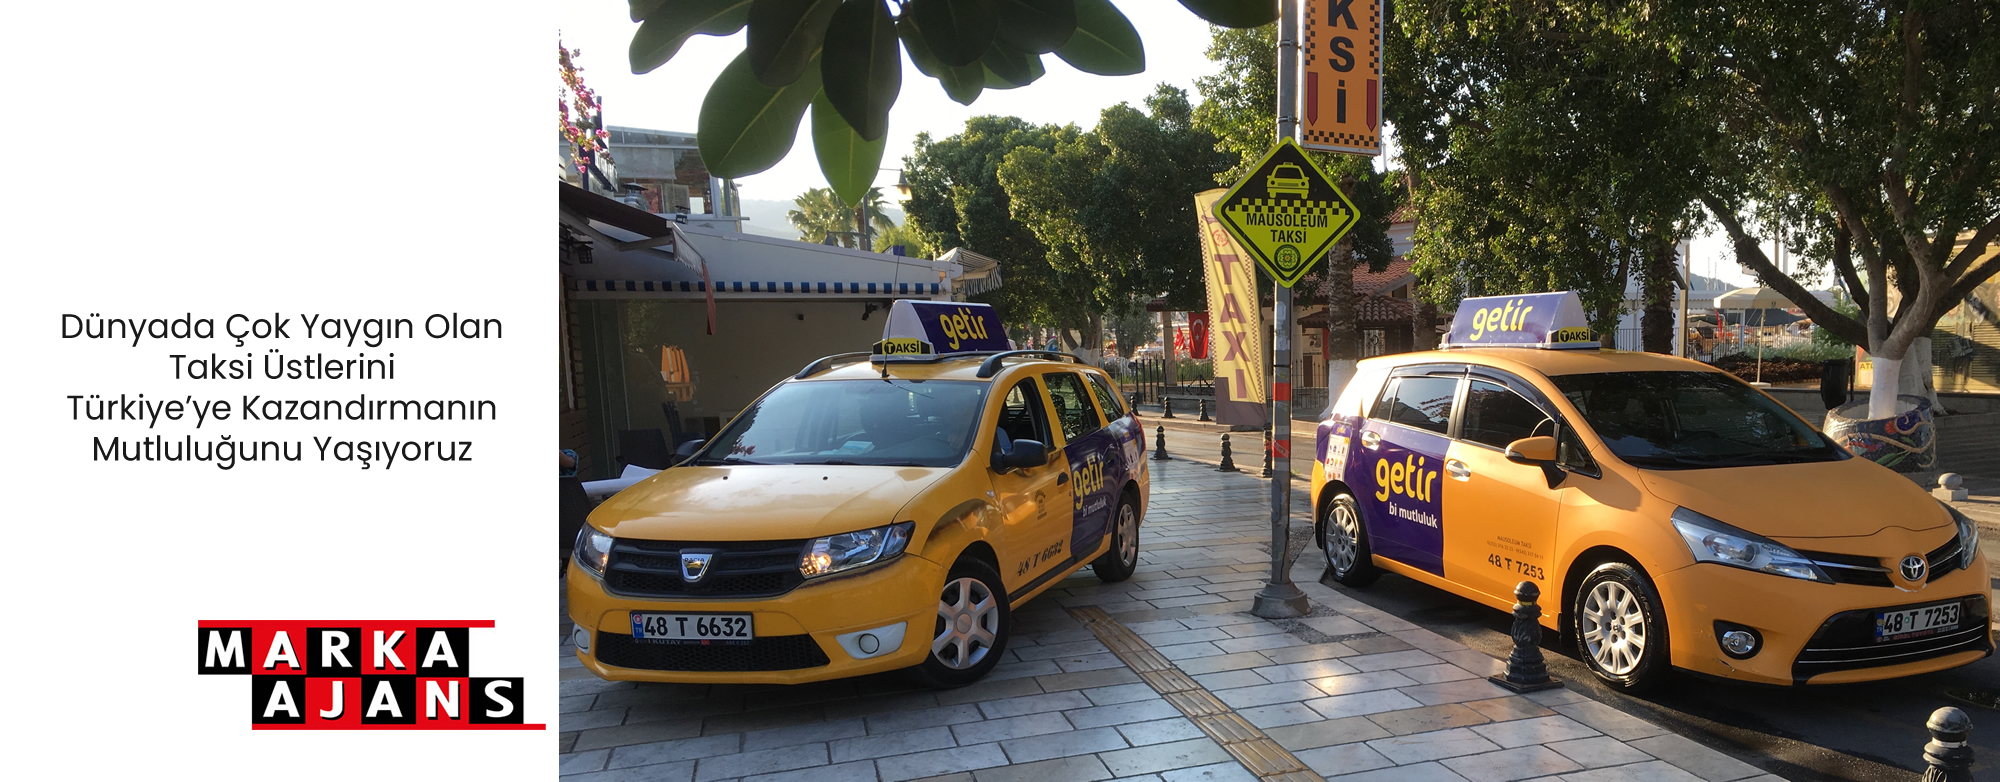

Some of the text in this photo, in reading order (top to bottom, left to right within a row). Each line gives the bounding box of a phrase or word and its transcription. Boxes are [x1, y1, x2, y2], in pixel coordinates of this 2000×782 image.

[1246, 212, 1328, 228] MAUSOLEUM
[1270, 228, 1307, 244] TAKSİ
[940, 306, 989, 350] getir
[1214, 253, 1251, 399] TAXI
[1469, 298, 1534, 342] getir
[884, 340, 920, 355] TAKSİ
[1560, 328, 1590, 343] TAKSİ
[1073, 454, 1104, 511] getir
[1375, 454, 1437, 503] getir
[1083, 496, 1107, 517] bi mutluluk
[1389, 501, 1438, 529] bi mutluluk
[1017, 539, 1064, 577] 48 T 6632
[1488, 553, 1545, 580] 48 T 7253
[644, 616, 748, 637] 48 T 6632
[1884, 613, 1904, 633] 48
[1909, 611, 1919, 630] T
[1924, 604, 1959, 627] 7253
